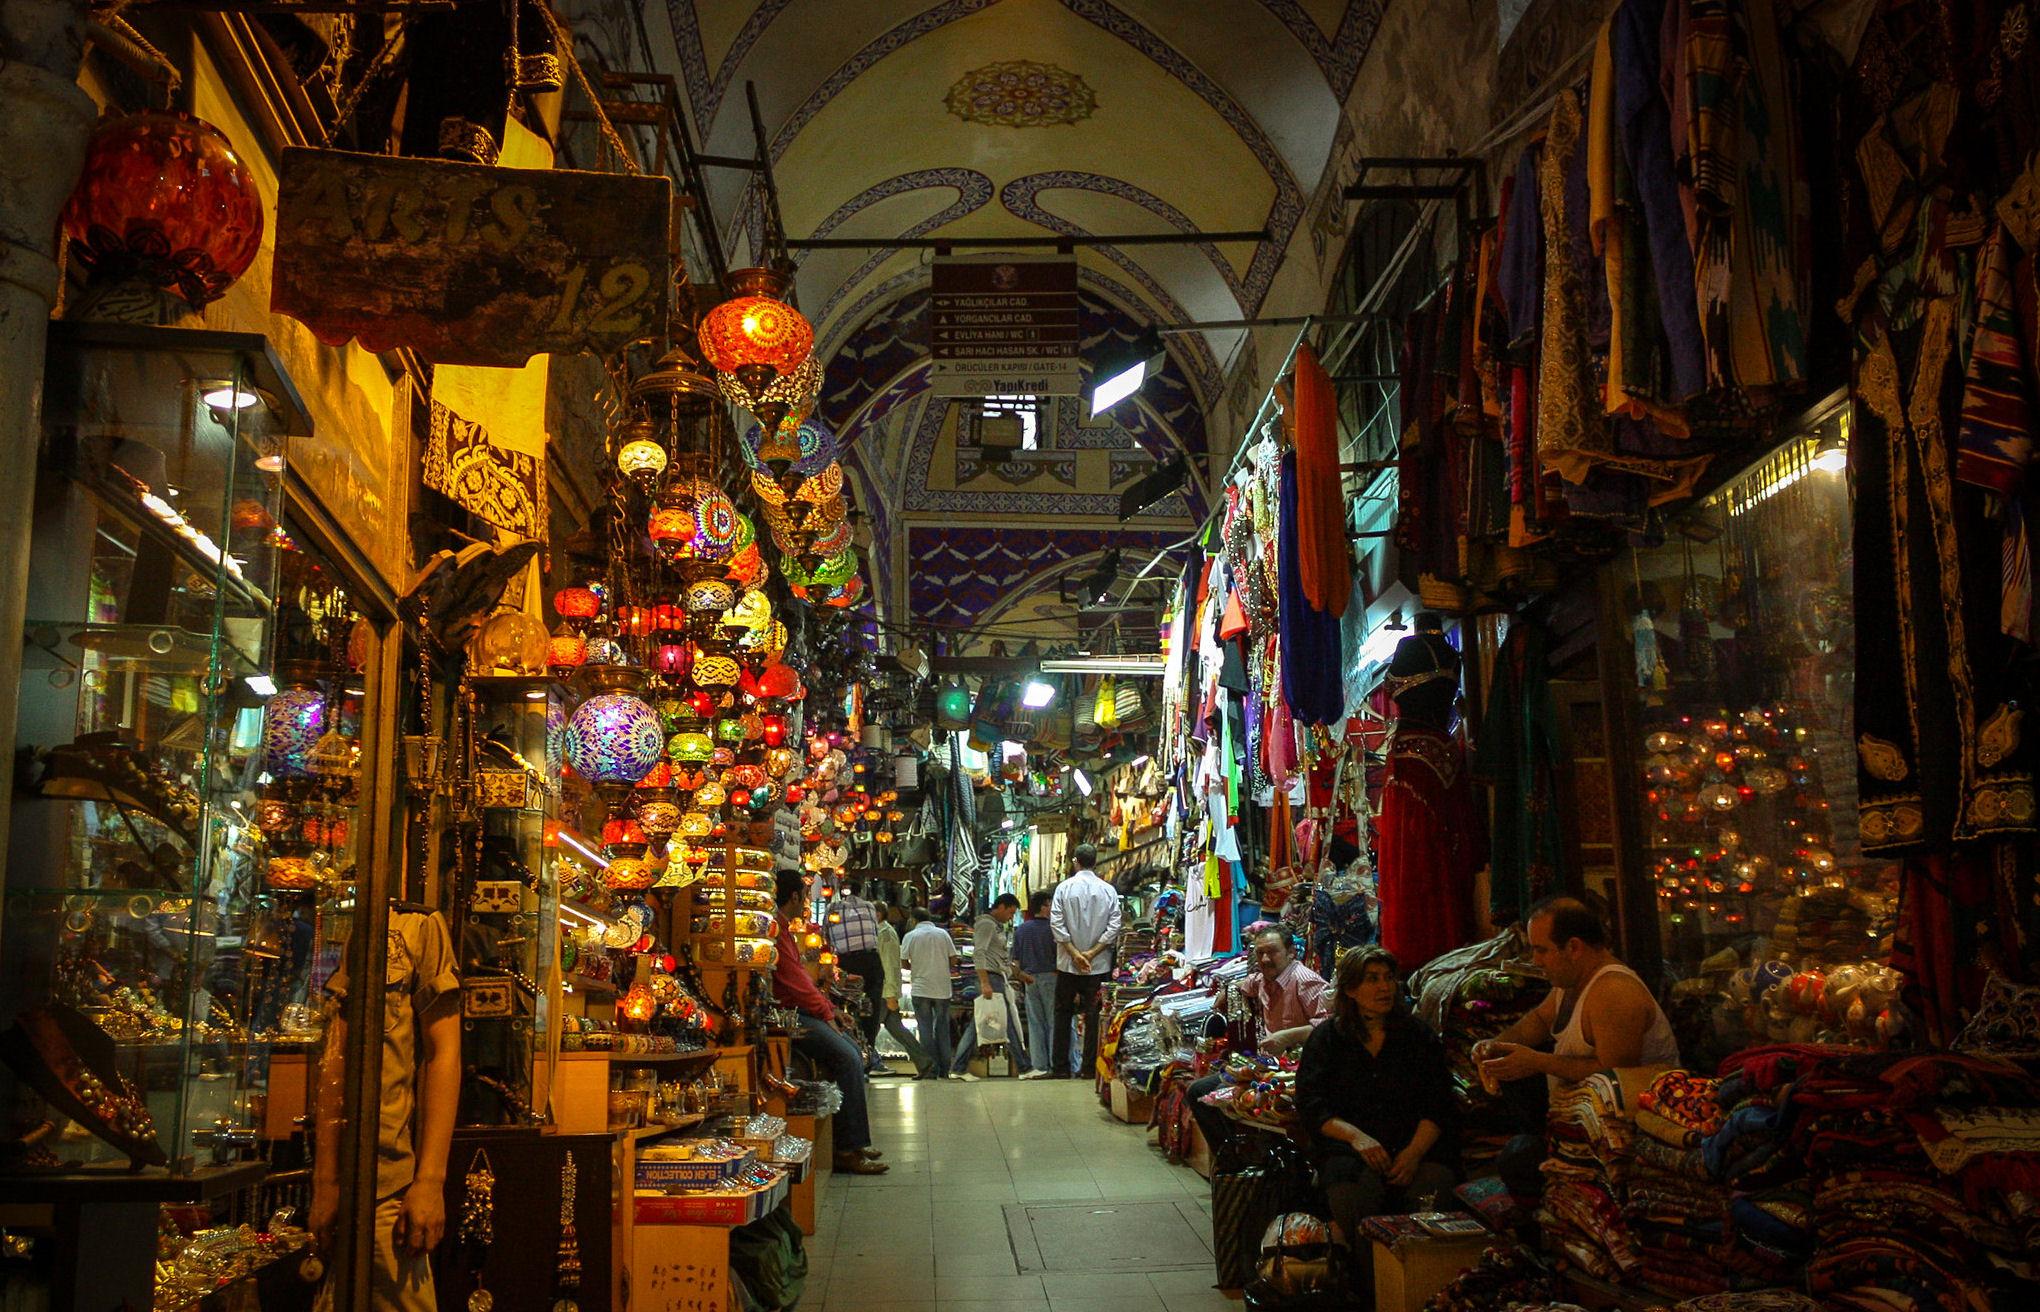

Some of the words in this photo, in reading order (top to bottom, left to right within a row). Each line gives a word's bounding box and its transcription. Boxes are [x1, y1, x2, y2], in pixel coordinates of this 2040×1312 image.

[549, 261, 652, 334] 12
[954, 298, 1008, 308] YAĞLIKÇILAR
[1009, 298, 1028, 307] CAD.
[954, 314, 1013, 323] YORGANCILAR
[1014, 314, 1033, 322] CAD.
[954, 329, 984, 339] EVLİYA
[985, 331, 1005, 339] HANI
[1010, 331, 1024, 339] WC
[954, 347, 974, 356] SARI
[975, 347, 995, 355] HACI
[996, 346, 1025, 355] HASAN
[1046, 346, 1060, 354] WC
[955, 362, 1000, 371] ÖRÜCÜLER
[1033, 362, 1068, 371] GATE-14
[993, 379, 1049, 393] YapıKredi
